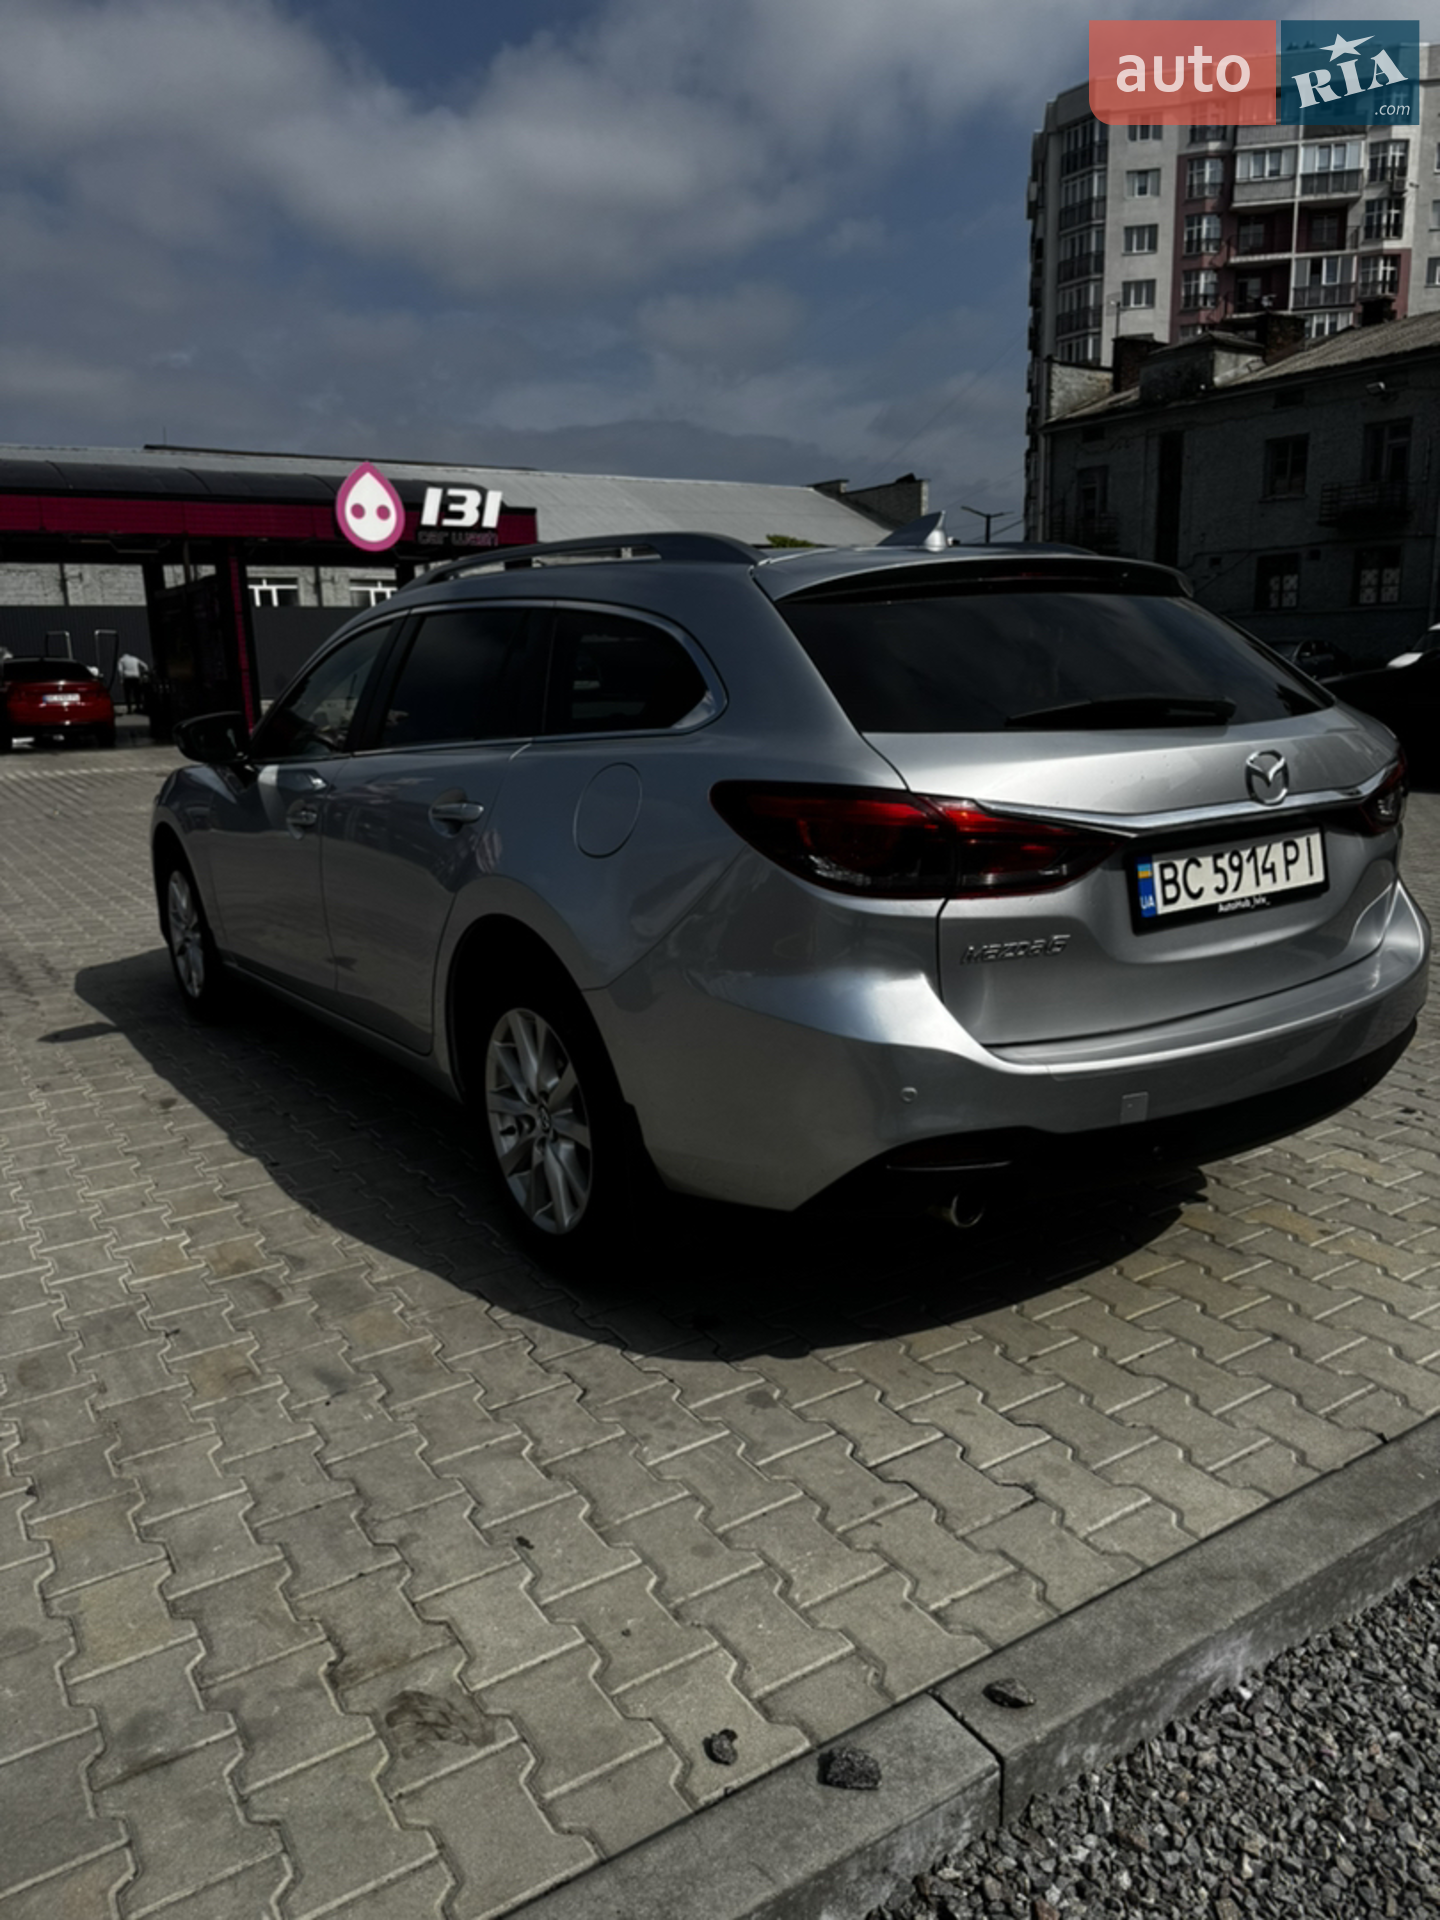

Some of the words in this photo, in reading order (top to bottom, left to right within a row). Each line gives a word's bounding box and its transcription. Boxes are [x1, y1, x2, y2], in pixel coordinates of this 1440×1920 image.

[417, 531, 449, 546] car
[1158, 857, 1204, 906] BC
[1212, 843, 1277, 895] 5914
[1282, 836, 1314, 882] PI
[1140, 895, 1156, 910] UA
